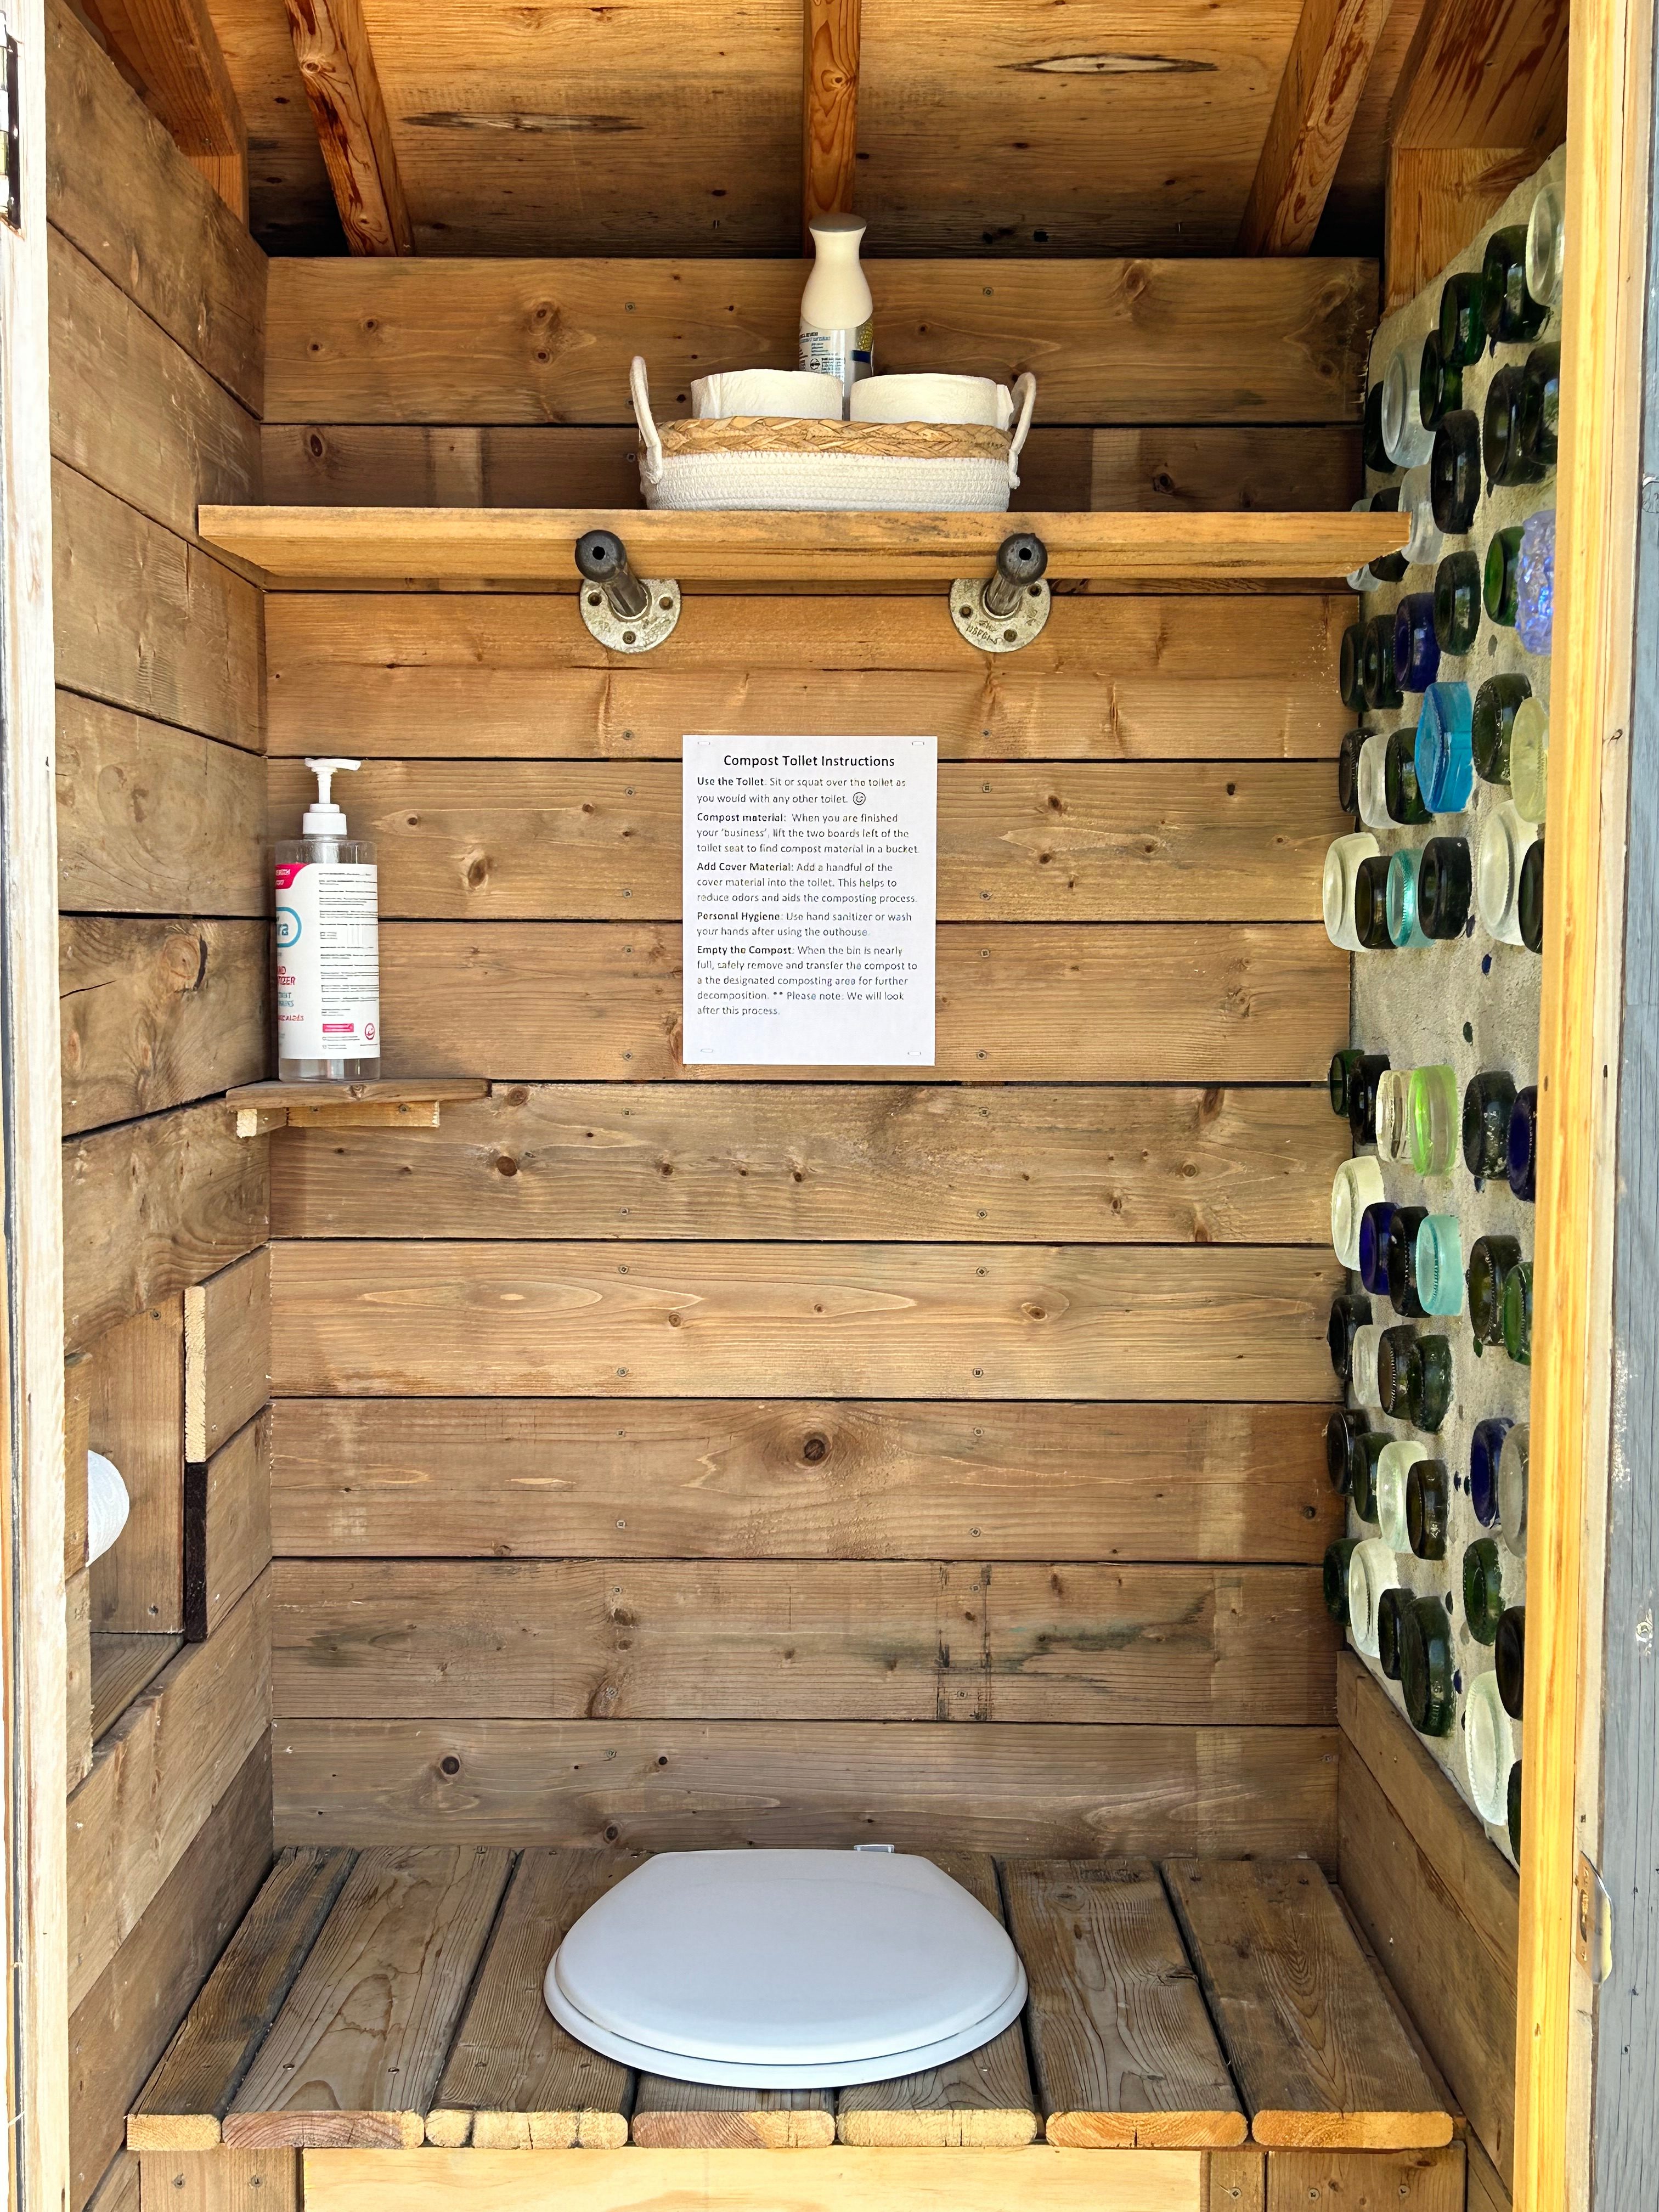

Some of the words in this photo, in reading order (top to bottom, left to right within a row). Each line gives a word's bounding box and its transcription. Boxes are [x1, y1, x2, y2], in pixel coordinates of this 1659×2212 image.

[724, 755, 779, 769] Compost
[782, 754, 818, 766] Toilet
[821, 755, 895, 767] Instructions
[697, 776, 715, 786] Use
[718, 776, 734, 786] the
[769, 777, 782, 786] Sit
[797, 778, 823, 788] squat
[850, 778, 866, 787] the
[868, 777, 894, 787] toilet
[697, 795, 714, 804] you
[716, 793, 746, 803] would
[749, 794, 770, 803] with
[772, 796, 790, 805] any
[792, 794, 819, 803] other
[697, 812, 740, 824] Compost
[791, 812, 820, 822] When
[822, 815, 840, 824] you
[861, 813, 898, 823] finished
[697, 830, 719, 839] your
[773, 828, 786, 838] lift
[788, 828, 804, 838] the
[806, 830, 825, 838] two
[827, 828, 860, 838] boards
[862, 828, 879, 838] left
[881, 828, 891, 838] of
[893, 829, 909, 838] the
[697, 843, 722, 853] toilet
[724, 844, 744, 853] seat
[759, 843, 778, 853] find
[780, 845, 822, 855] compost
[824, 844, 864, 853] material
[866, 844, 875, 854] in
[697, 861, 716, 871] Add
[719, 862, 747, 871] Cover
[796, 862, 815, 872] Add
[826, 862, 862, 872] handful
[865, 862, 874, 872] of
[877, 862, 893, 872] the
[725, 877, 766, 887] material
[768, 877, 786, 887] into
[789, 877, 805, 887] the
[837, 877, 857, 887] This
[859, 878, 884, 889] helps
[887, 879, 897, 888] to
[697, 893, 729, 902] reduce
[732, 893, 759, 902] odors
[761, 893, 779, 902] and
[782, 893, 801, 902] aids
[803, 893, 819, 902] the
[821, 893, 877, 905] composting
[697, 911, 738, 921] Personal
[786, 912, 804, 921] Use
[806, 911, 830, 921] hand
[832, 912, 873, 921] sanitizer
[887, 912, 912, 922] wash
[697, 928, 719, 938] your
[721, 927, 749, 936] hands
[752, 927, 775, 936] after
[777, 927, 802, 938] using
[804, 927, 820, 936] the
[697, 945, 728, 956] Empty
[730, 945, 746, 955] the
[797, 945, 825, 955] When
[828, 945, 844, 955] the
[847, 945, 861, 955] bin
[864, 946, 871, 955] is
[874, 946, 902, 957] nearly
[717, 960, 745, 971] safely
[786, 961, 803, 969] and
[806, 961, 844, 970] transfer
[846, 961, 861, 970] the
[864, 962, 905, 972] compost
[705, 975, 721, 985] the
[723, 975, 775, 986] designated
[777, 976, 832, 987] composting
[859, 975, 873, 985] for
[875, 975, 909, 986] further
[787, 990, 816, 1001] Please
[847, 991, 863, 1001] We
[865, 991, 882, 1001] will
[884, 991, 904, 1001] look
[697, 1005, 720, 1015] after
[722, 1006, 740, 1015] this
